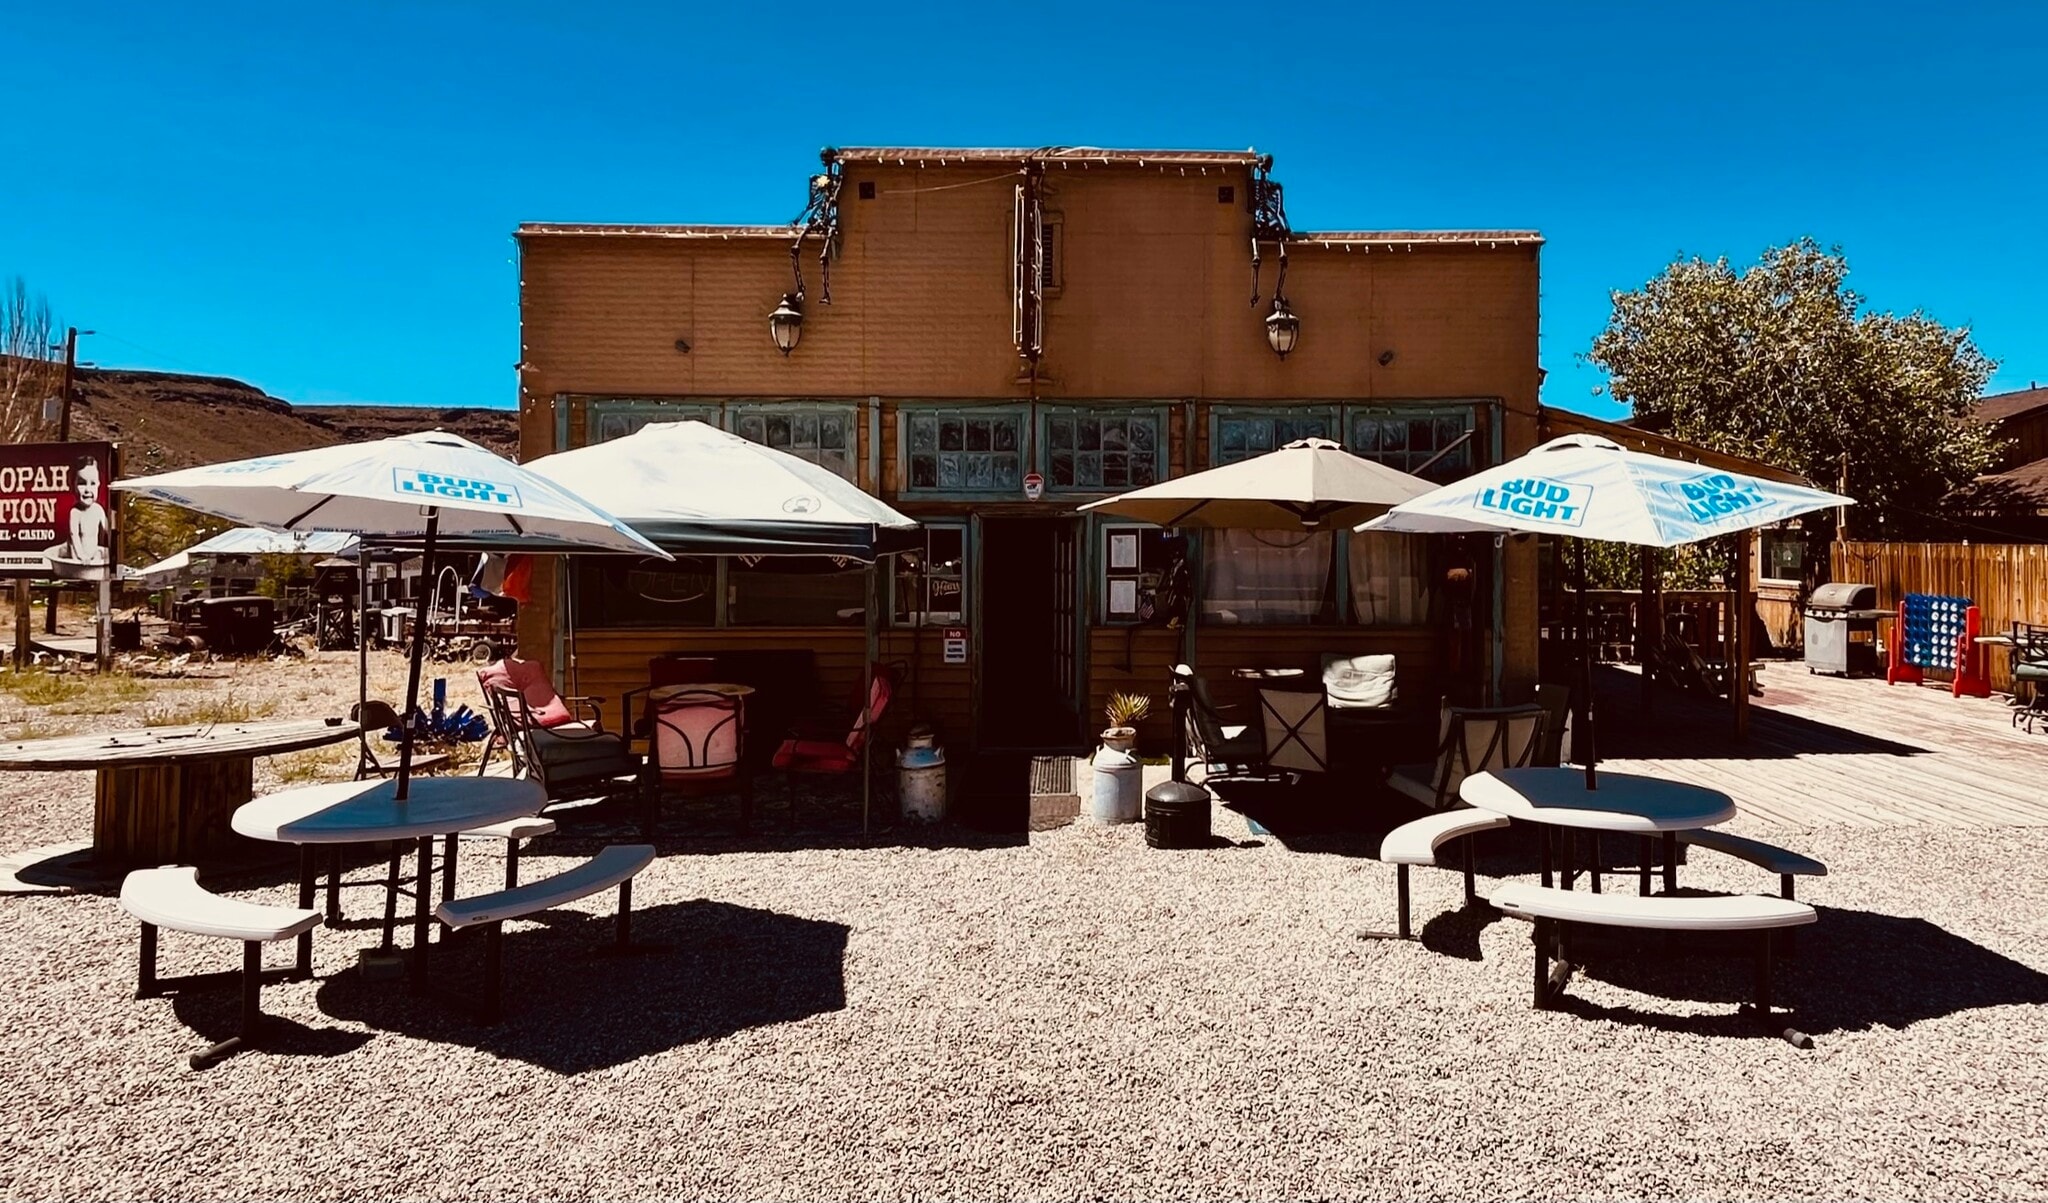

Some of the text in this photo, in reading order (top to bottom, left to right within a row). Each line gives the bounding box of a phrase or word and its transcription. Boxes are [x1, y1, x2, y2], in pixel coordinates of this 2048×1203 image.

[0, 466, 70, 493] OPAH
[402, 481, 512, 503] LIGHT
[417, 472, 496, 491] BUD
[1501, 477, 1570, 503] BUD
[1679, 474, 1736, 501] BUD
[0, 498, 57, 523] TION
[1482, 488, 1579, 520] LIGHT
[1689, 487, 1764, 521] LIGHT
[18, 529, 55, 540] CASINO
